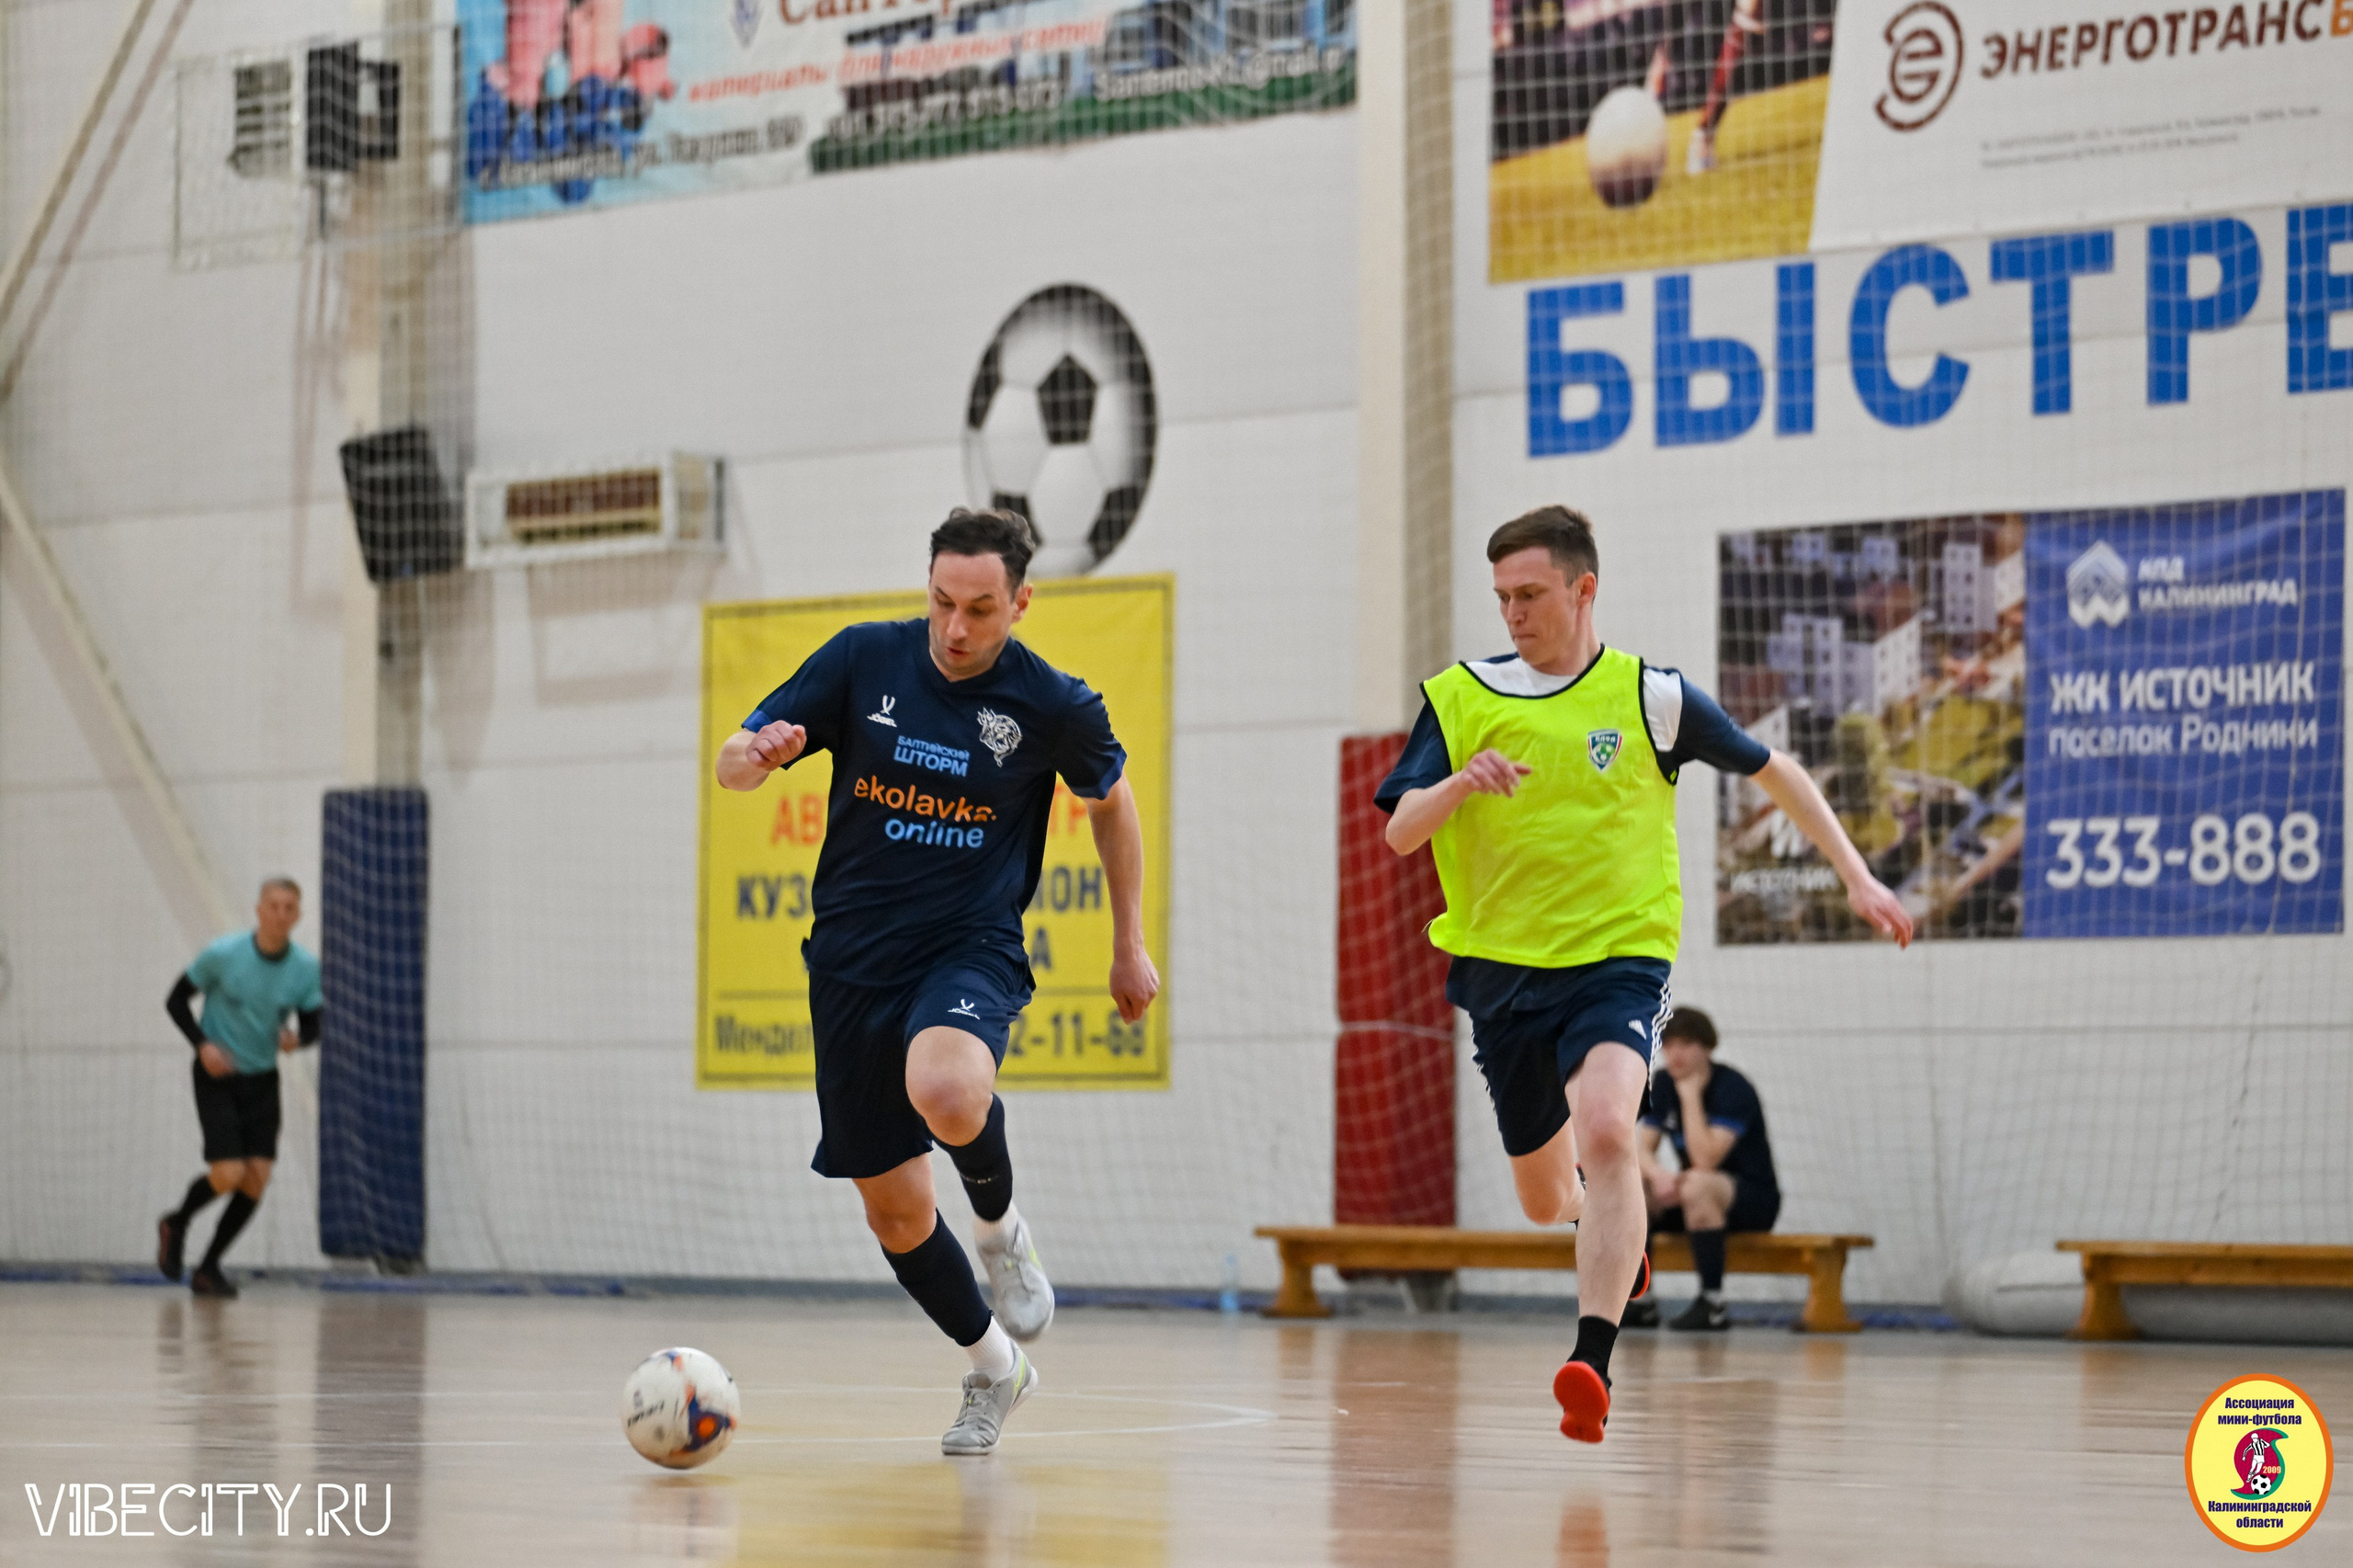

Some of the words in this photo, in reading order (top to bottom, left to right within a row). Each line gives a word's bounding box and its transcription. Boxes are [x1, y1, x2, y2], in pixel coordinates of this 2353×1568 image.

[2137, 577, 2298, 610] КАЛИНИНГРАД
[2051, 670, 2110, 714] ЖК
[2119, 661, 2314, 710] ИСТОЧНИК
[897, 734, 971, 762] БАЛТИЙСКИЙ
[2049, 724, 2174, 757] поселок
[2180, 713, 2318, 757] Родники
[892, 745, 969, 778] ШТОРМ
[884, 818, 984, 848] online
[2045, 811, 2321, 889] 333-888
